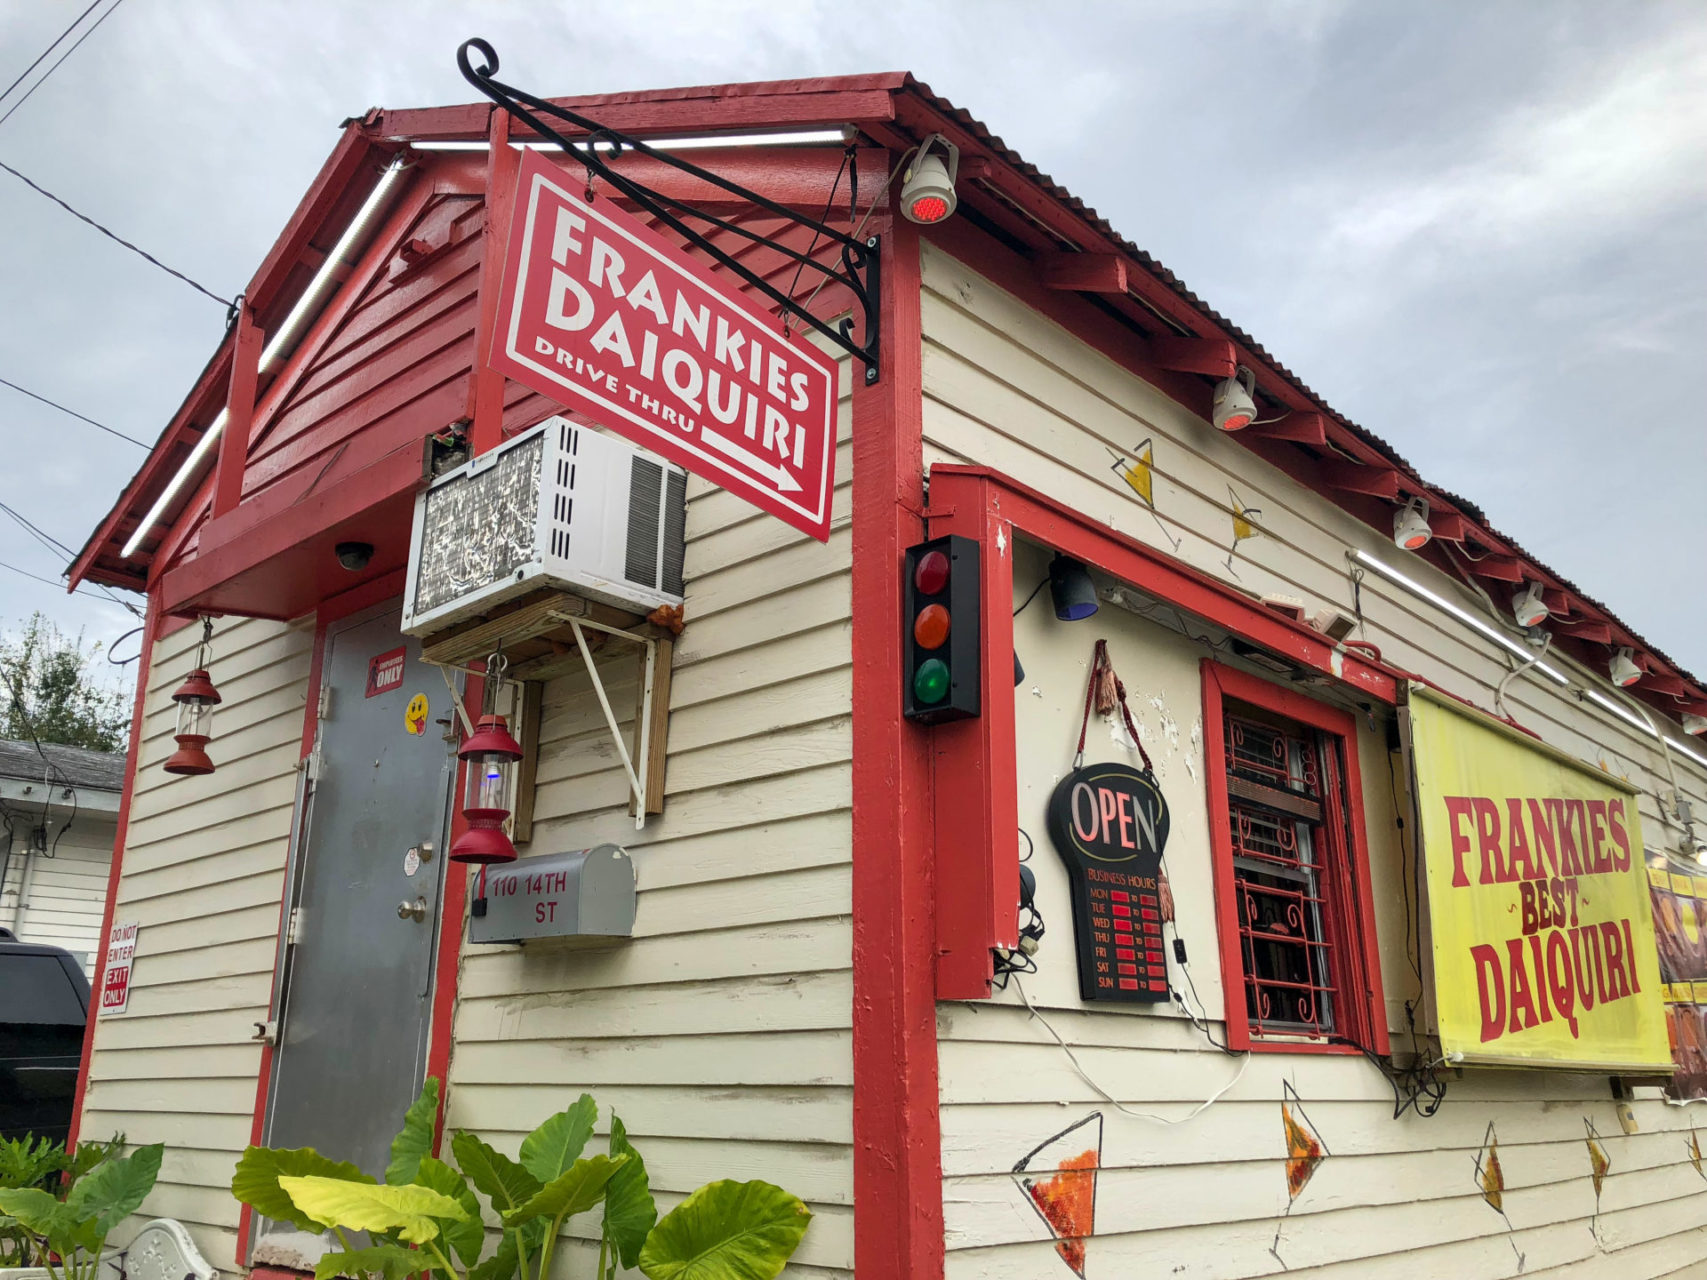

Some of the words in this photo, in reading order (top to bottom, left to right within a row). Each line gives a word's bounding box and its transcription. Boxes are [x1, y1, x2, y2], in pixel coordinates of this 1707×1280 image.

[551, 205, 808, 411] FRANKIES
[545, 266, 806, 469] DAIQUIRI
[534, 335, 618, 393] DRIVE
[626, 384, 694, 433] THRU
[377, 664, 403, 688] ONLY
[1071, 782, 1157, 853] OPEN
[1443, 796, 1631, 888] FRANKIES
[492, 876, 517, 897] 110
[525, 871, 567, 896] 14TH
[1088, 868, 1125, 885] BUSINESS
[1128, 876, 1156, 890] HOURS
[1090, 888, 1108, 899] MON
[535, 902, 558, 923] ST
[1090, 902, 1105, 913] TUE
[1518, 876, 1580, 936] BEST
[1093, 917, 1110, 928] WED
[111, 928, 121, 943] DO
[122, 925, 137, 941] NOT
[1094, 932, 1109, 943] THU
[108, 945, 133, 962] ENTER
[1095, 947, 1106, 958] FRI
[106, 967, 128, 985] EXIT
[1097, 962, 1109, 973] SAT
[1098, 977, 1113, 988] SUN
[1470, 918, 1642, 1043] DAIQUIRI
[104, 988, 126, 1004] ONLY
